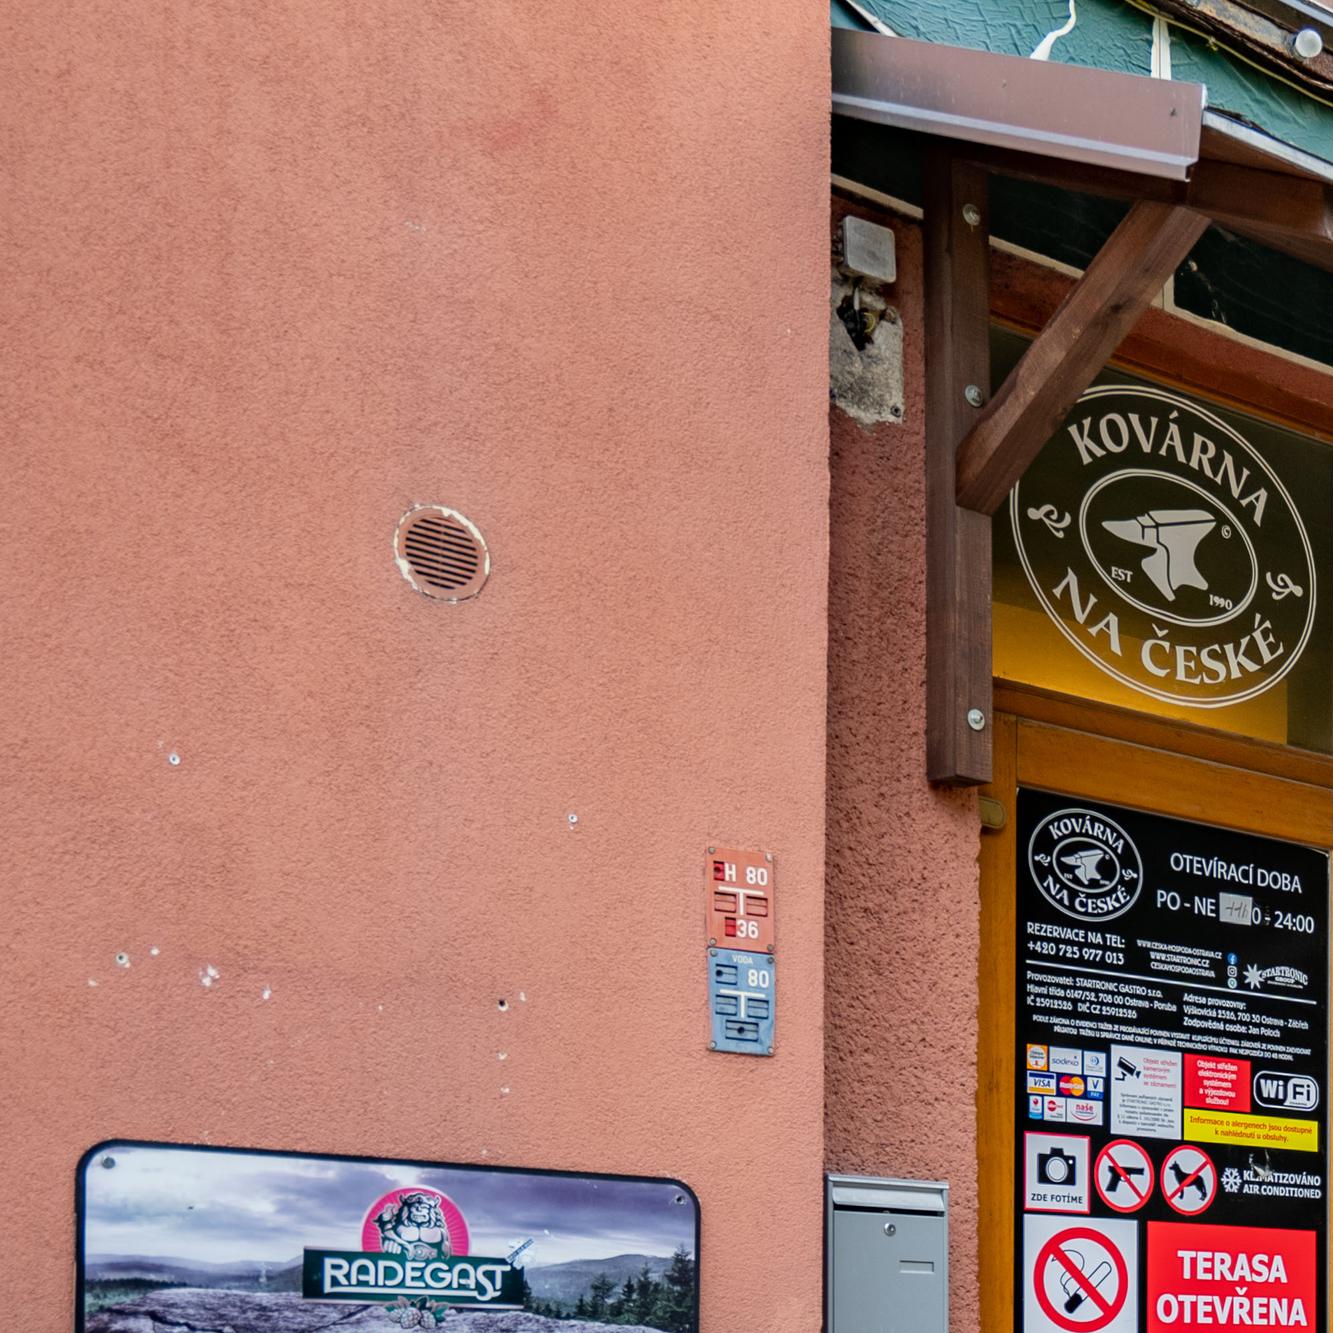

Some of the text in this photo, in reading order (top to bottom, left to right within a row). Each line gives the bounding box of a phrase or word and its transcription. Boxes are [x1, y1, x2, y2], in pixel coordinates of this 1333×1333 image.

[1067, 410, 1269, 528] KOVÁRNA
[1111, 566, 1133, 583] EST
[1208, 594, 1233, 610] 1990
[1052, 567, 1284, 684] NA ČESKÉ
[1048, 815, 1124, 854] KOVÁRNA
[725, 863, 768, 886] H 80
[1170, 852, 1302, 894] OTEVÍRACÍ DOBA
[1043, 874, 1130, 914] NA ČESKÉ
[1156, 889, 1181, 911] PO
[1194, 895, 1216, 918] NE
[737, 920, 759, 939] 36
[1274, 911, 1314, 934] 24:00
[1027, 922, 1125, 948] REZERVACE NA TEL:
[732, 955, 754, 965] VODA
[1027, 940, 1124, 965] +420 725 977 013
[748, 970, 770, 989] 80
[1075, 977, 1118, 992] STARTRONIC
[1119, 983, 1146, 996] GASTRO
[1033, 1078, 1051, 1088] VISA
[1190, 1116, 1224, 1127] Informace
[1232, 1119, 1267, 1132] alergenech
[1268, 1123, 1282, 1133] jsou
[1283, 1124, 1312, 1135] dostupné
[1243, 1170, 1321, 1187] KLMATIZOVÁNO
[1031, 1193, 1083, 1204] ZDE FOTÍME
[1243, 1183, 1321, 1199] AIR CONDITIONED
[324, 1257, 512, 1300] RADEGAST
[1177, 1250, 1287, 1284] TERASA
[1156, 1287, 1308, 1327] OTEVŘENA
